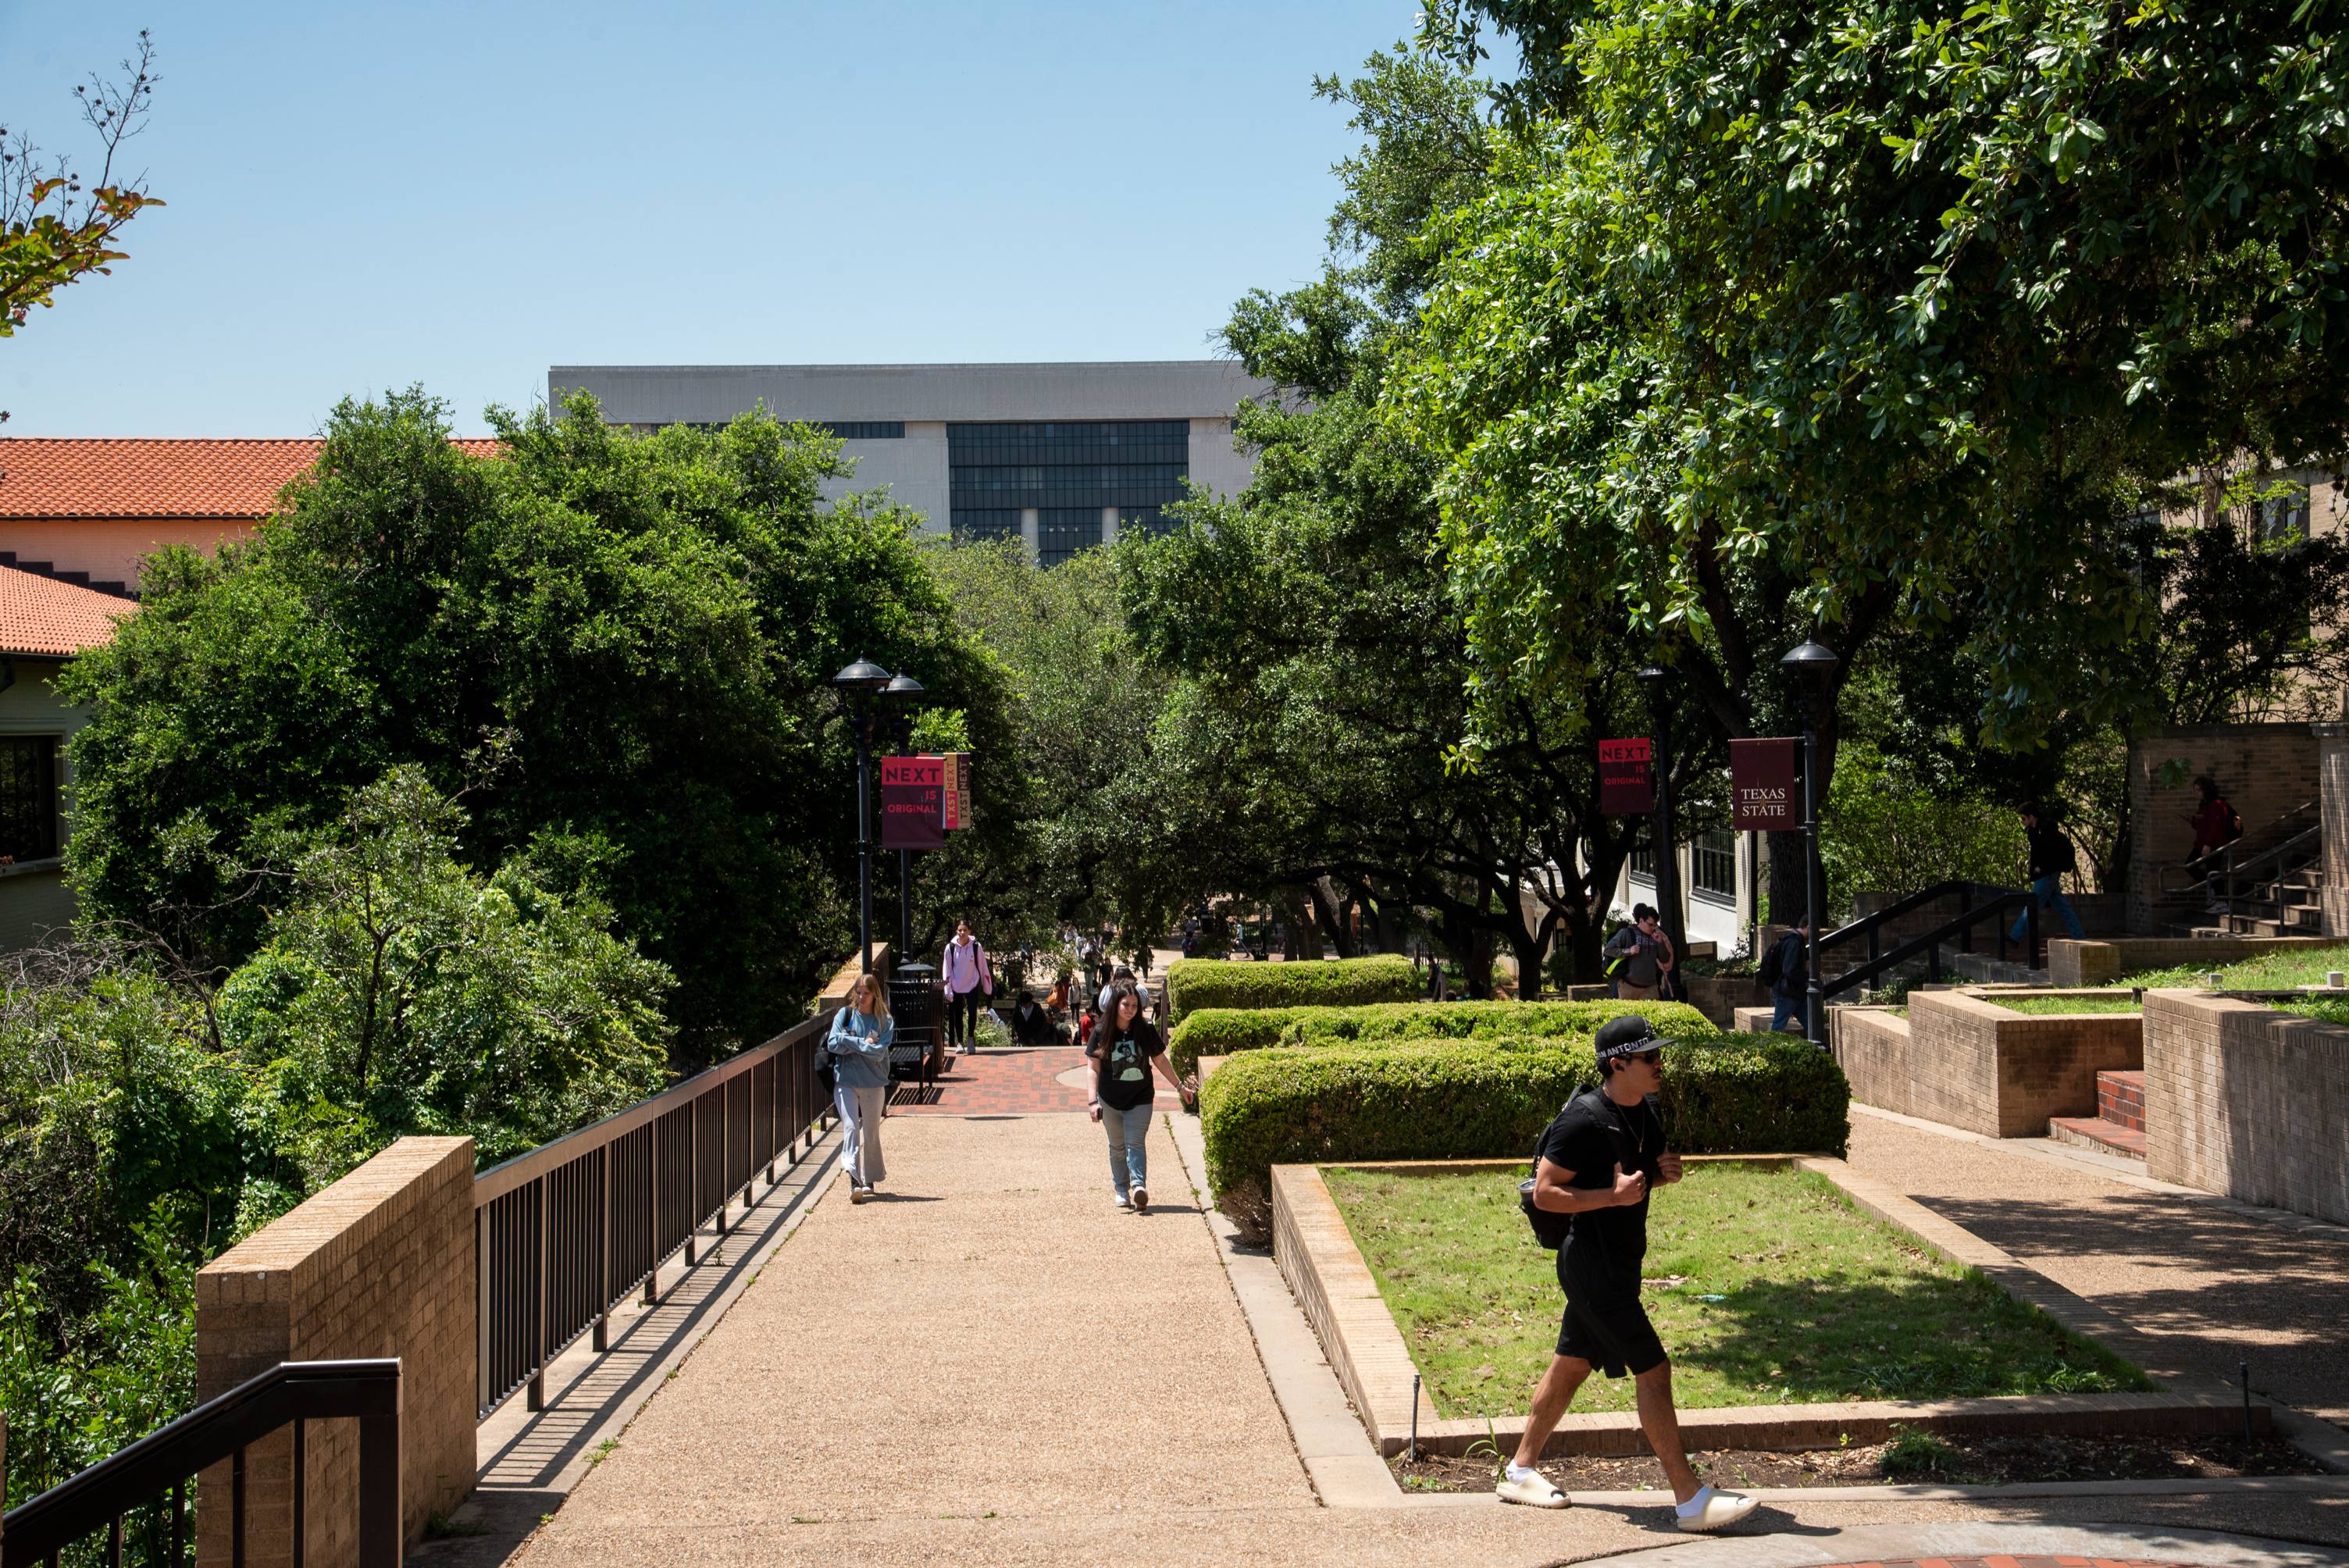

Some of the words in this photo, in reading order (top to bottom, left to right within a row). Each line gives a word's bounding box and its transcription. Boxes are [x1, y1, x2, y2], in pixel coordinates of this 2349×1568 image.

[1602, 747, 1647, 760] NEXT
[1636, 764, 1645, 773] IS
[886, 768, 940, 782] NEXT
[1604, 777, 1645, 786] ORIGINAL
[925, 790, 937, 800] IS
[1741, 788, 1785, 800] TEXAS
[887, 804, 936, 813] ORIGINAL
[1741, 804, 1785, 817] STATE
